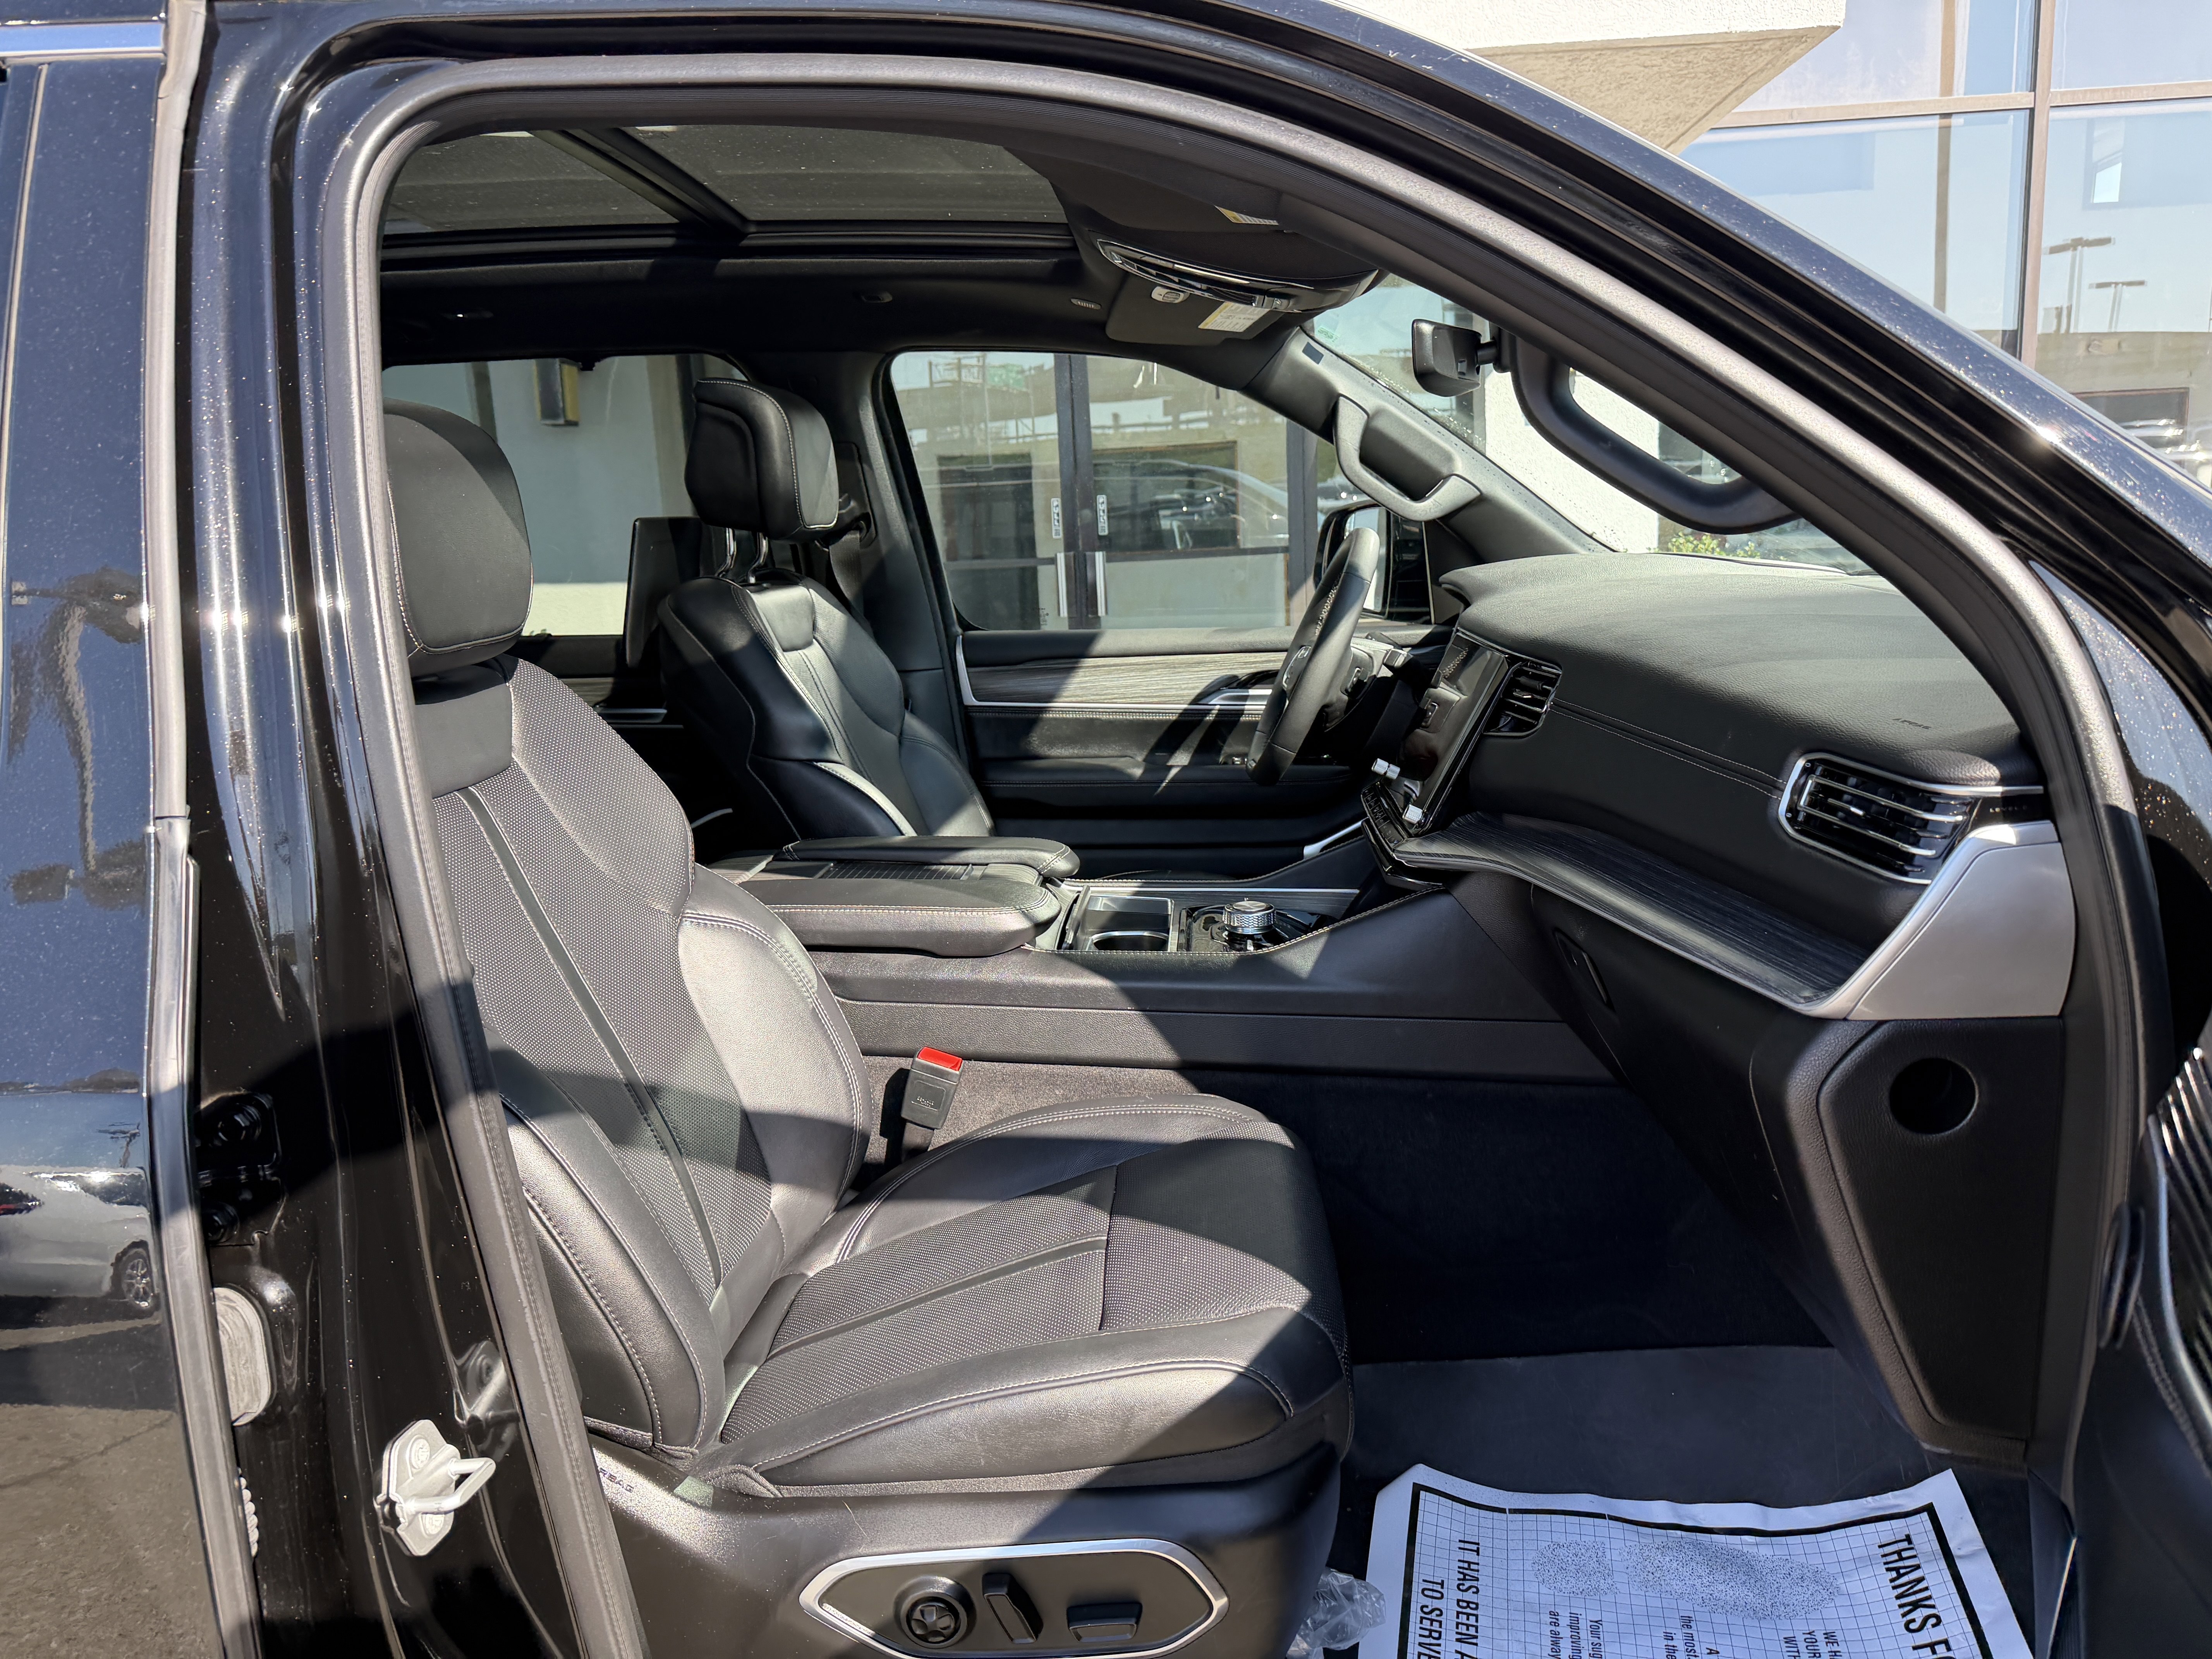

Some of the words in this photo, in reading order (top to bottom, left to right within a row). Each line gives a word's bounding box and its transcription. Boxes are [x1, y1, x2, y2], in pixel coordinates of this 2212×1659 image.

[1458, 1539, 1480, 1556] IT
[1456, 1559, 1480, 1595] HAS
[1421, 1579, 1444, 1600] TO
[1877, 1534, 1942, 1633] THANKS
[1912, 1637, 1956, 1659] F
[1455, 1599, 1479, 1646] BEEN
[1549, 1611, 1560, 1627] are
[1589, 1619, 1602, 1640] Your
[1680, 1615, 1694, 1629] the
[1417, 1605, 1443, 1659] SERVE
[1566, 1612, 1585, 1659] improving
[1663, 1631, 1676, 1640] in
[1823, 1631, 1839, 1647] WE
[1589, 1642, 1603, 1659] sug
[1664, 1644, 1679, 1659] the
[1683, 1632, 1700, 1659] most
[1802, 1630, 1821, 1658] YOUR
[1828, 1650, 1843, 1659] H
